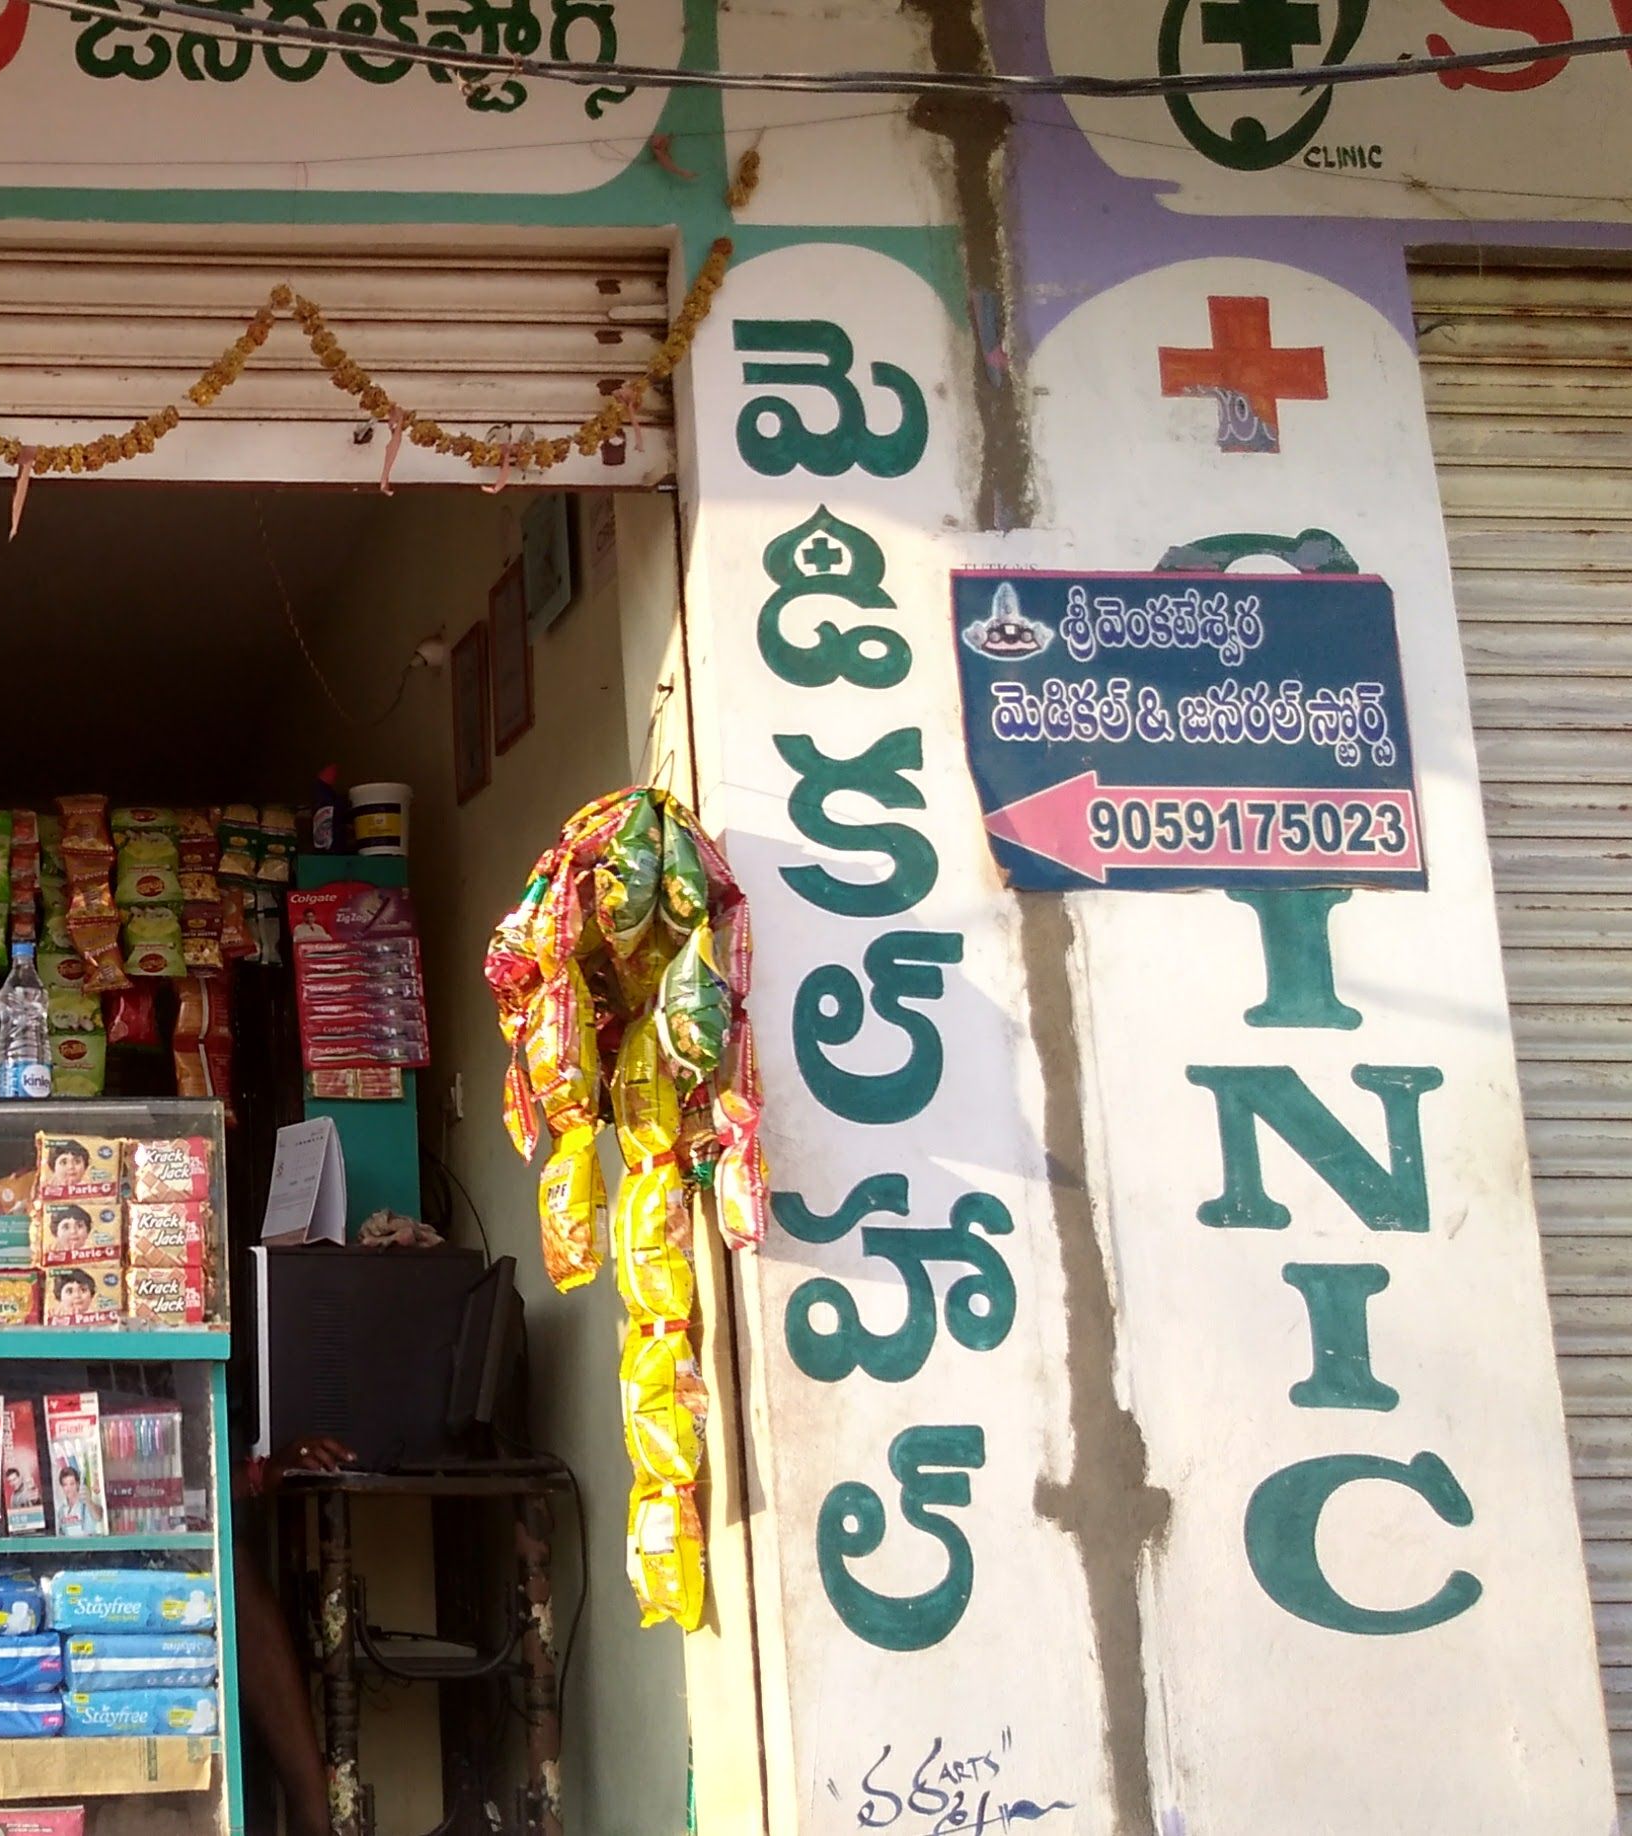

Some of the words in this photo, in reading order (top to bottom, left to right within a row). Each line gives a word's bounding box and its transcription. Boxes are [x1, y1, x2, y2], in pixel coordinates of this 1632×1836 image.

[1302, 144, 1383, 170] CLINIC
[1136, 687, 1174, 742] &
[1088, 797, 1409, 857] 9059175023
[290, 894, 338, 905] Colgate
[146, 1149, 184, 1163] Krack
[160, 1165, 192, 1180] Jack
[68, 1183, 112, 1195] Parle-G
[547, 1183, 568, 1202] PIPE
[138, 1213, 179, 1229] Krack
[153, 1229, 185, 1246] Jack
[71, 1247, 115, 1259] Parle-G
[138, 1279, 178, 1295] Krack
[153, 1297, 185, 1313] Jack
[74, 1595, 142, 1617] Stayfree
[82, 1705, 149, 1726] Stayfree
